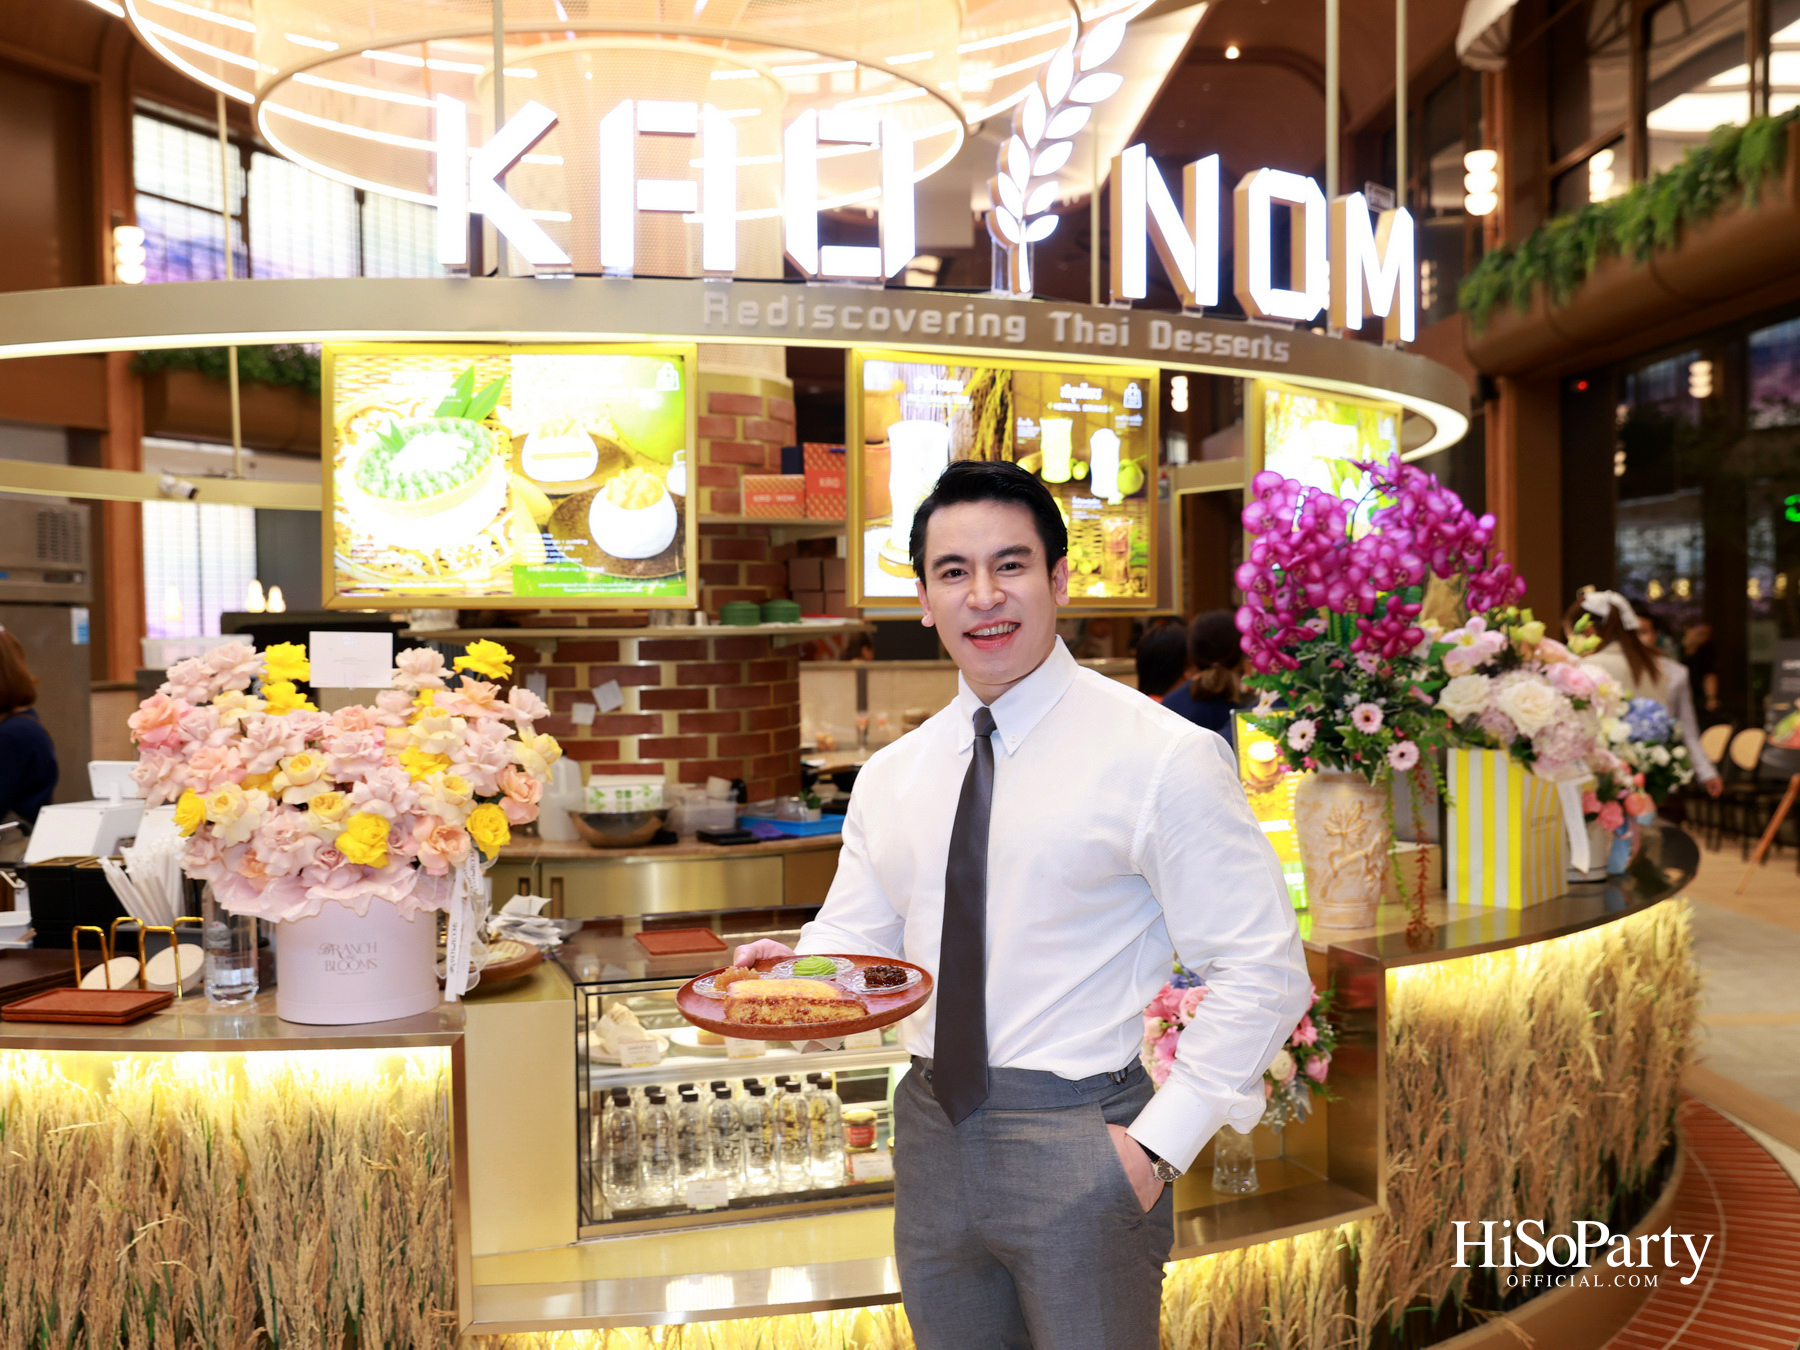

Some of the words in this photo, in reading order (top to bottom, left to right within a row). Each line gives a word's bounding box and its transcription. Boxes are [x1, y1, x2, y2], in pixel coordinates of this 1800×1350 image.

[437, 93, 916, 279] KAO
[1113, 142, 1416, 343] NOM
[702, 291, 1027, 343] Rediscovering
[1050, 311, 1129, 348] Thai
[1150, 320, 1290, 362] Desserts
[318, 942, 377, 959] BRANCH
[325, 958, 378, 972] BLOOMS
